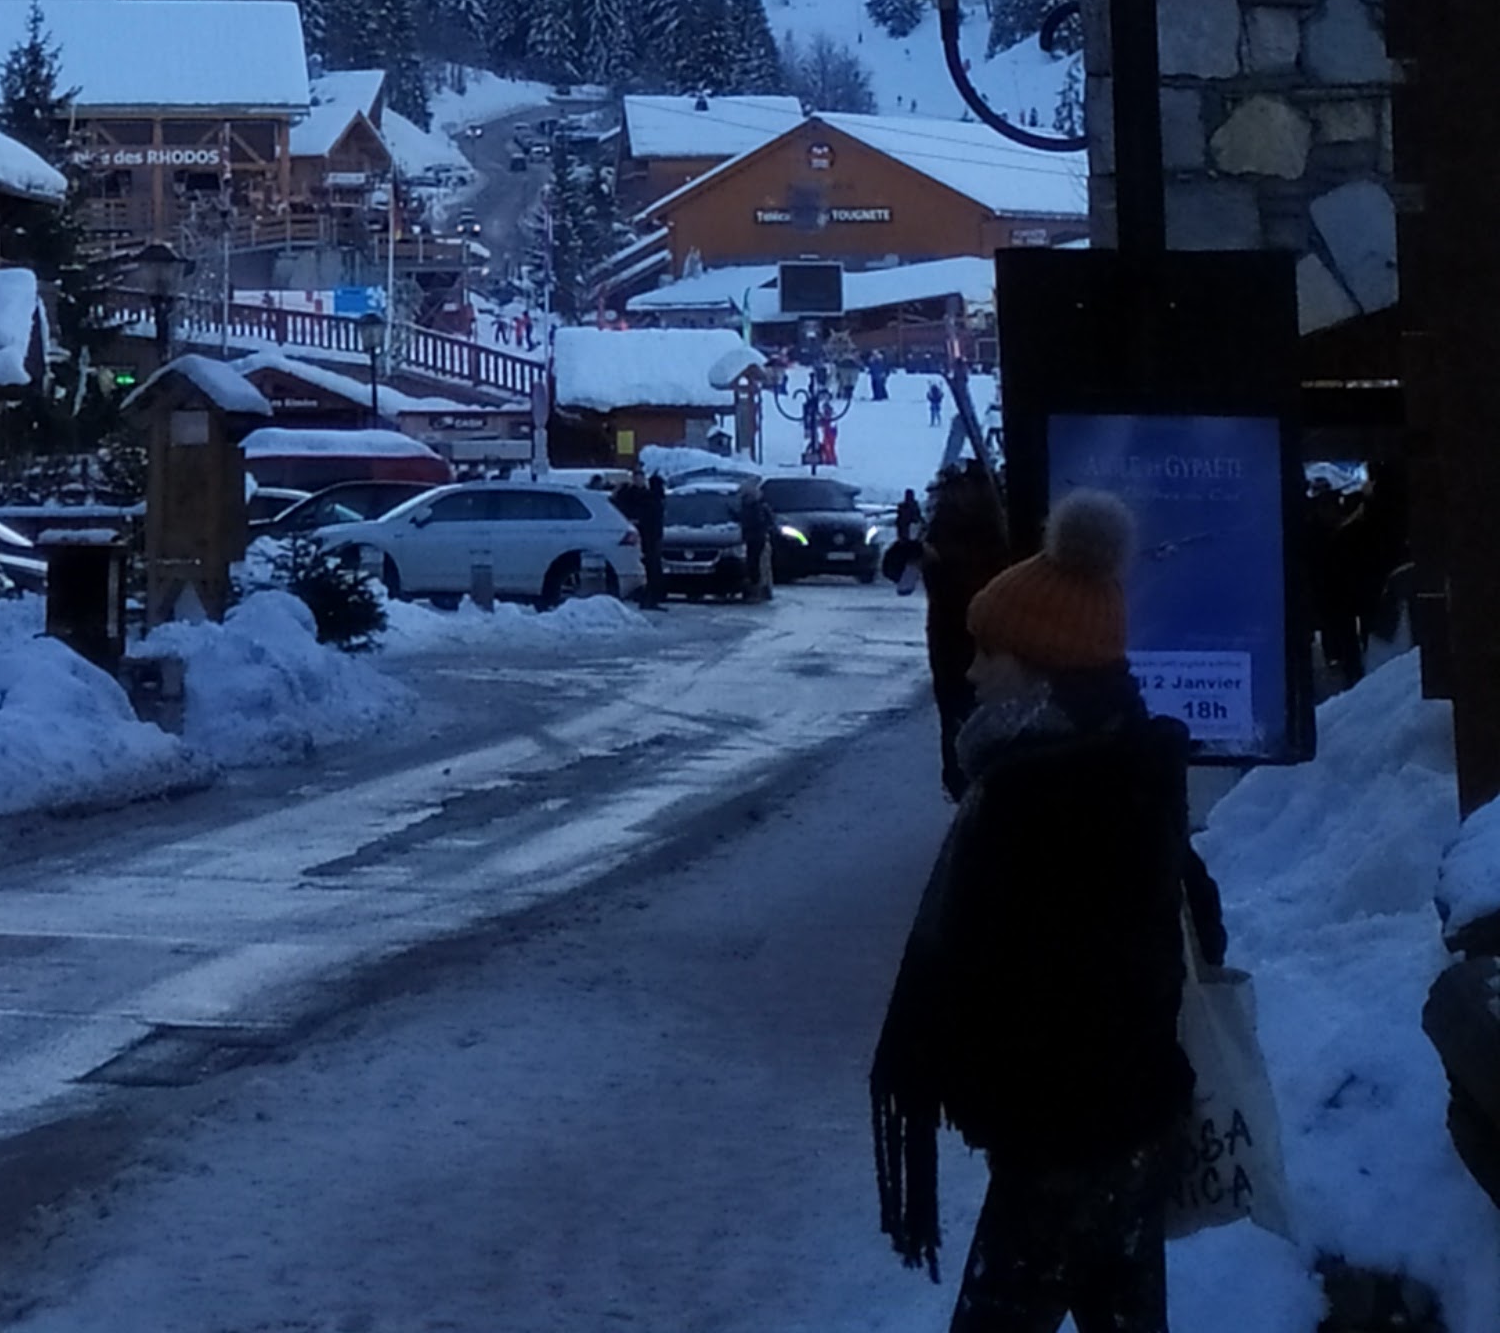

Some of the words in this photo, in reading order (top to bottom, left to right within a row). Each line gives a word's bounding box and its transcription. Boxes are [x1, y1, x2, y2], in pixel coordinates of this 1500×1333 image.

[113, 149, 143, 165] des
[146, 149, 220, 165] RHODOS
[1153, 675, 1166, 690] 2
[1170, 675, 1243, 690] Janvier
[1182, 700, 1229, 720] 18h
